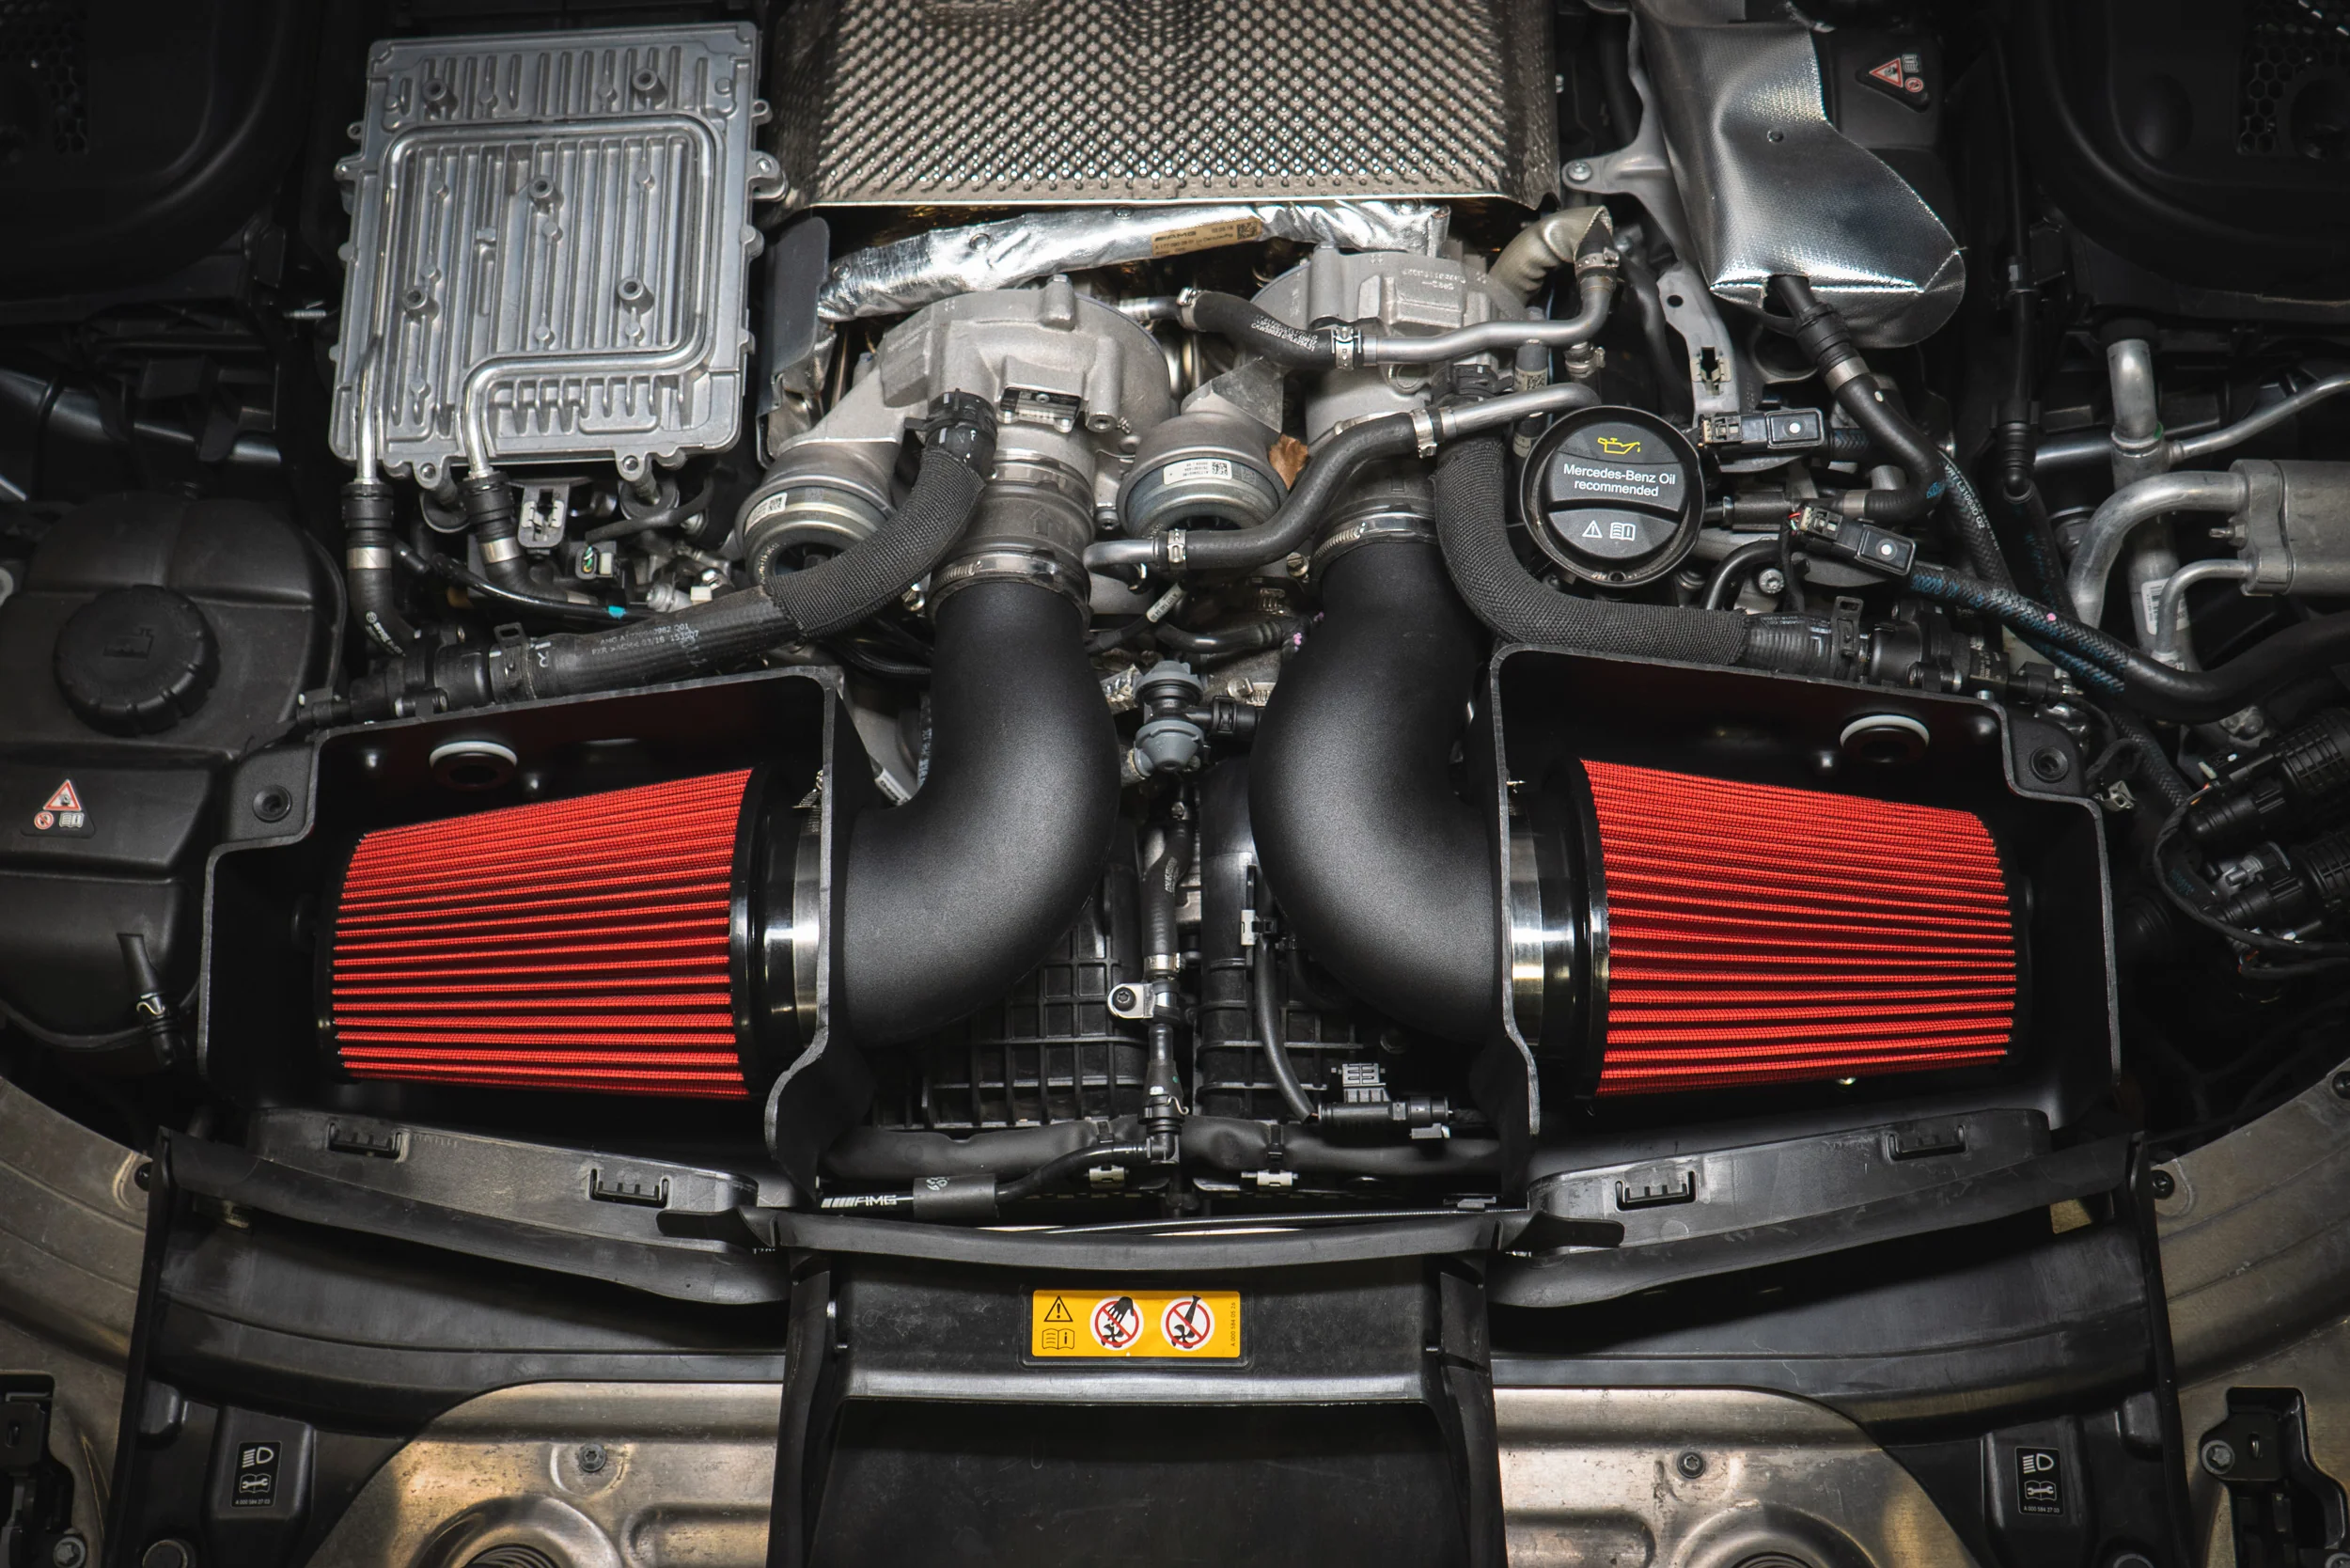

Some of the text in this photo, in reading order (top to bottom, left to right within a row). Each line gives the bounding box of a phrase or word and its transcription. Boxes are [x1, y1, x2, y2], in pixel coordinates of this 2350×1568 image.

[1563, 463, 1676, 485] Mercedes-Benz Oil
[1574, 479, 1659, 497] recommended
[1945, 463, 1960, 481] VRT
[1976, 516, 1985, 530] Q2
[854, 1194, 897, 1207] AMG
